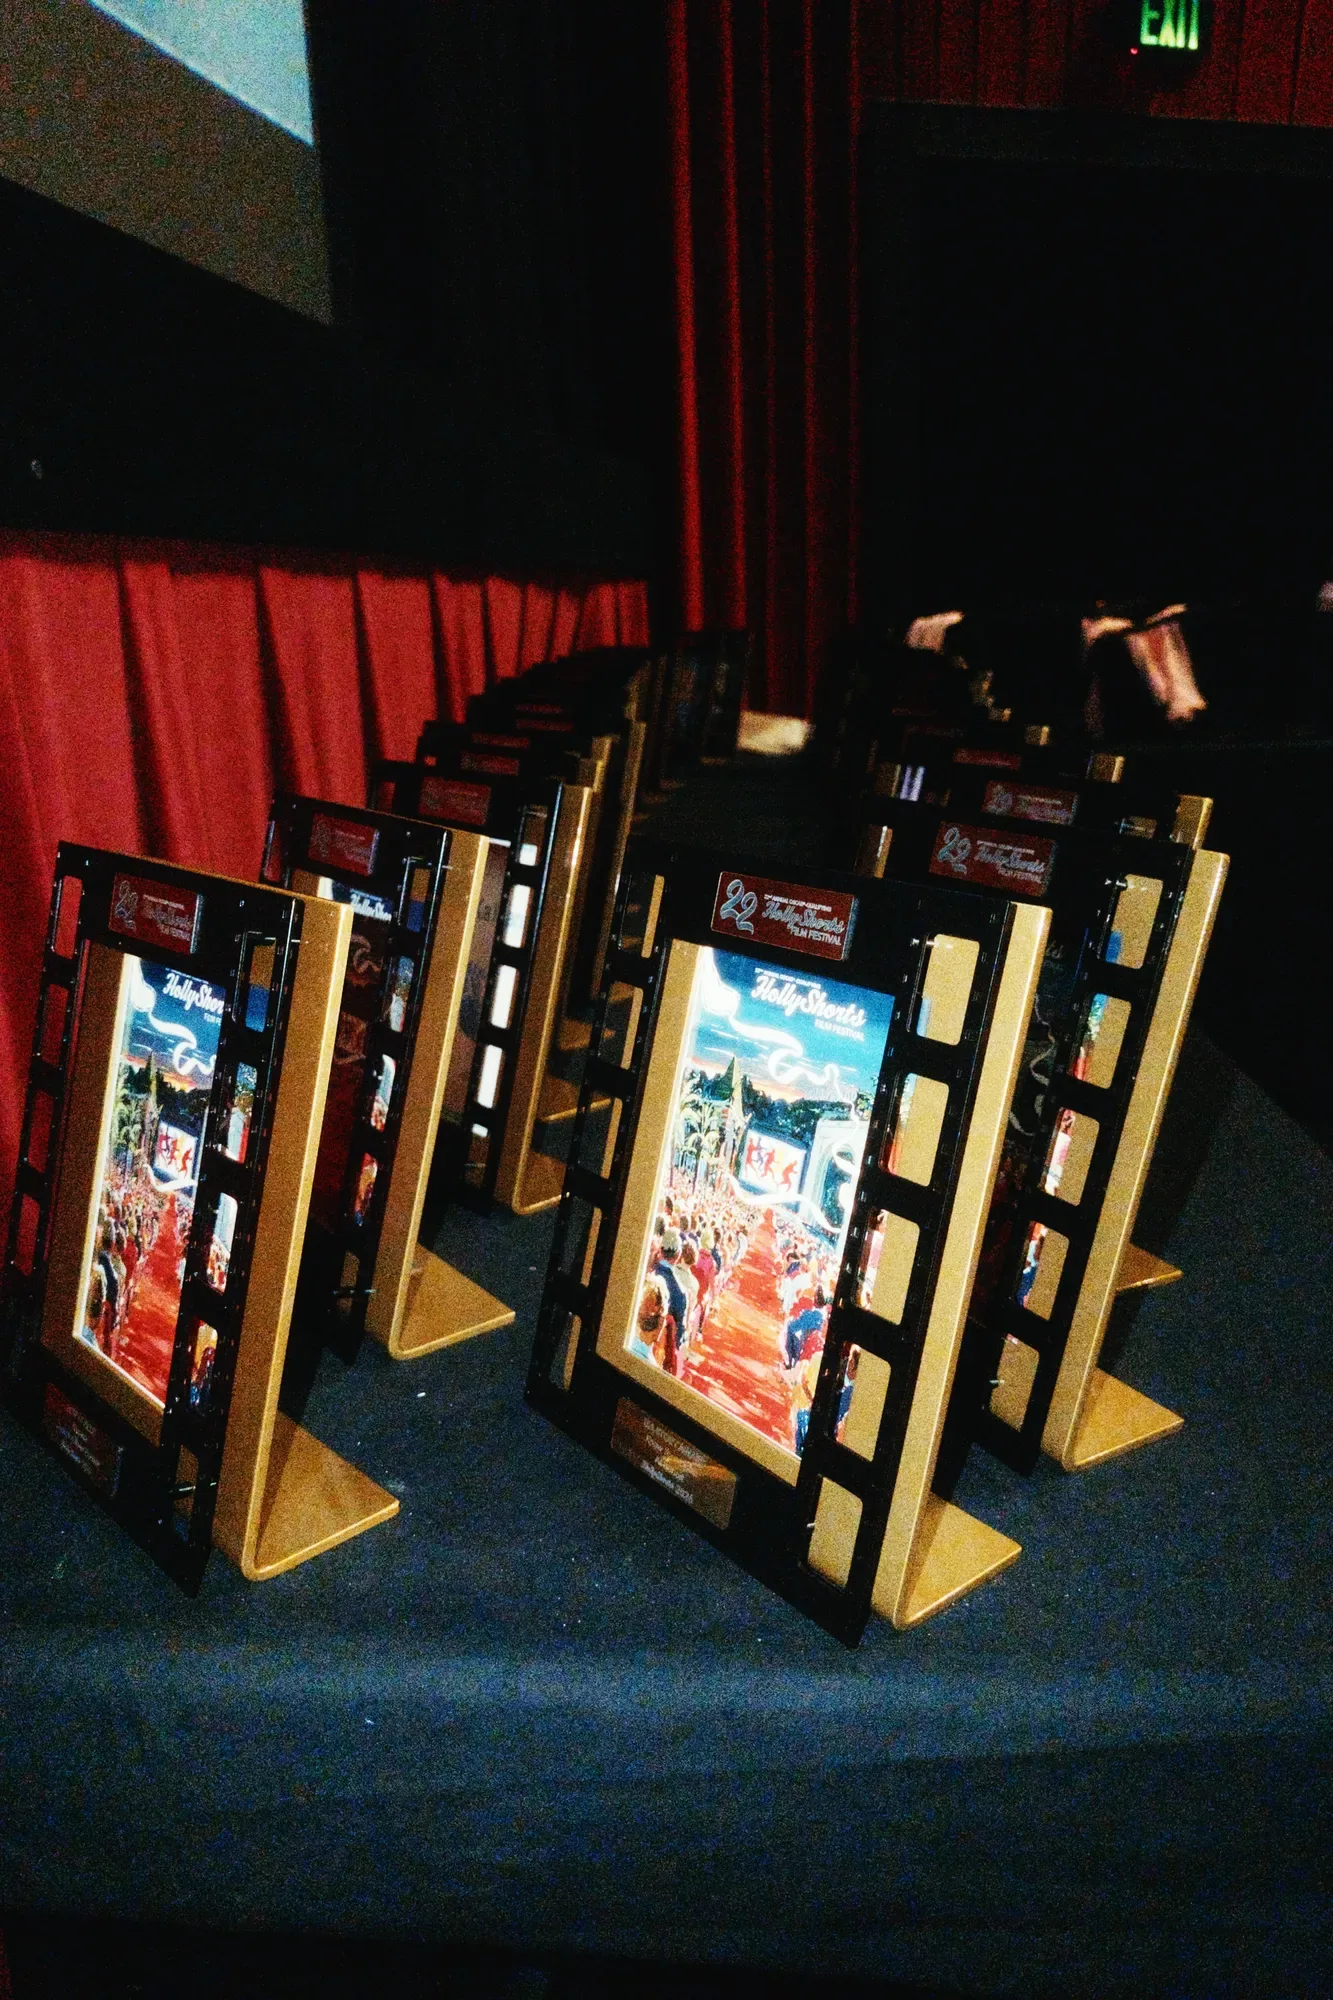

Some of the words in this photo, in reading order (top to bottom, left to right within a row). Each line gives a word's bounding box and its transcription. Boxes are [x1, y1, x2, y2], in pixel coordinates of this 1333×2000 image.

[719, 879, 758, 935] 22
[762, 901, 845, 934] HollyShorts
[790, 926, 807, 938] FILM
[808, 930, 842, 946] FESTIVAL
[751, 975, 867, 1027] HollyShorts
